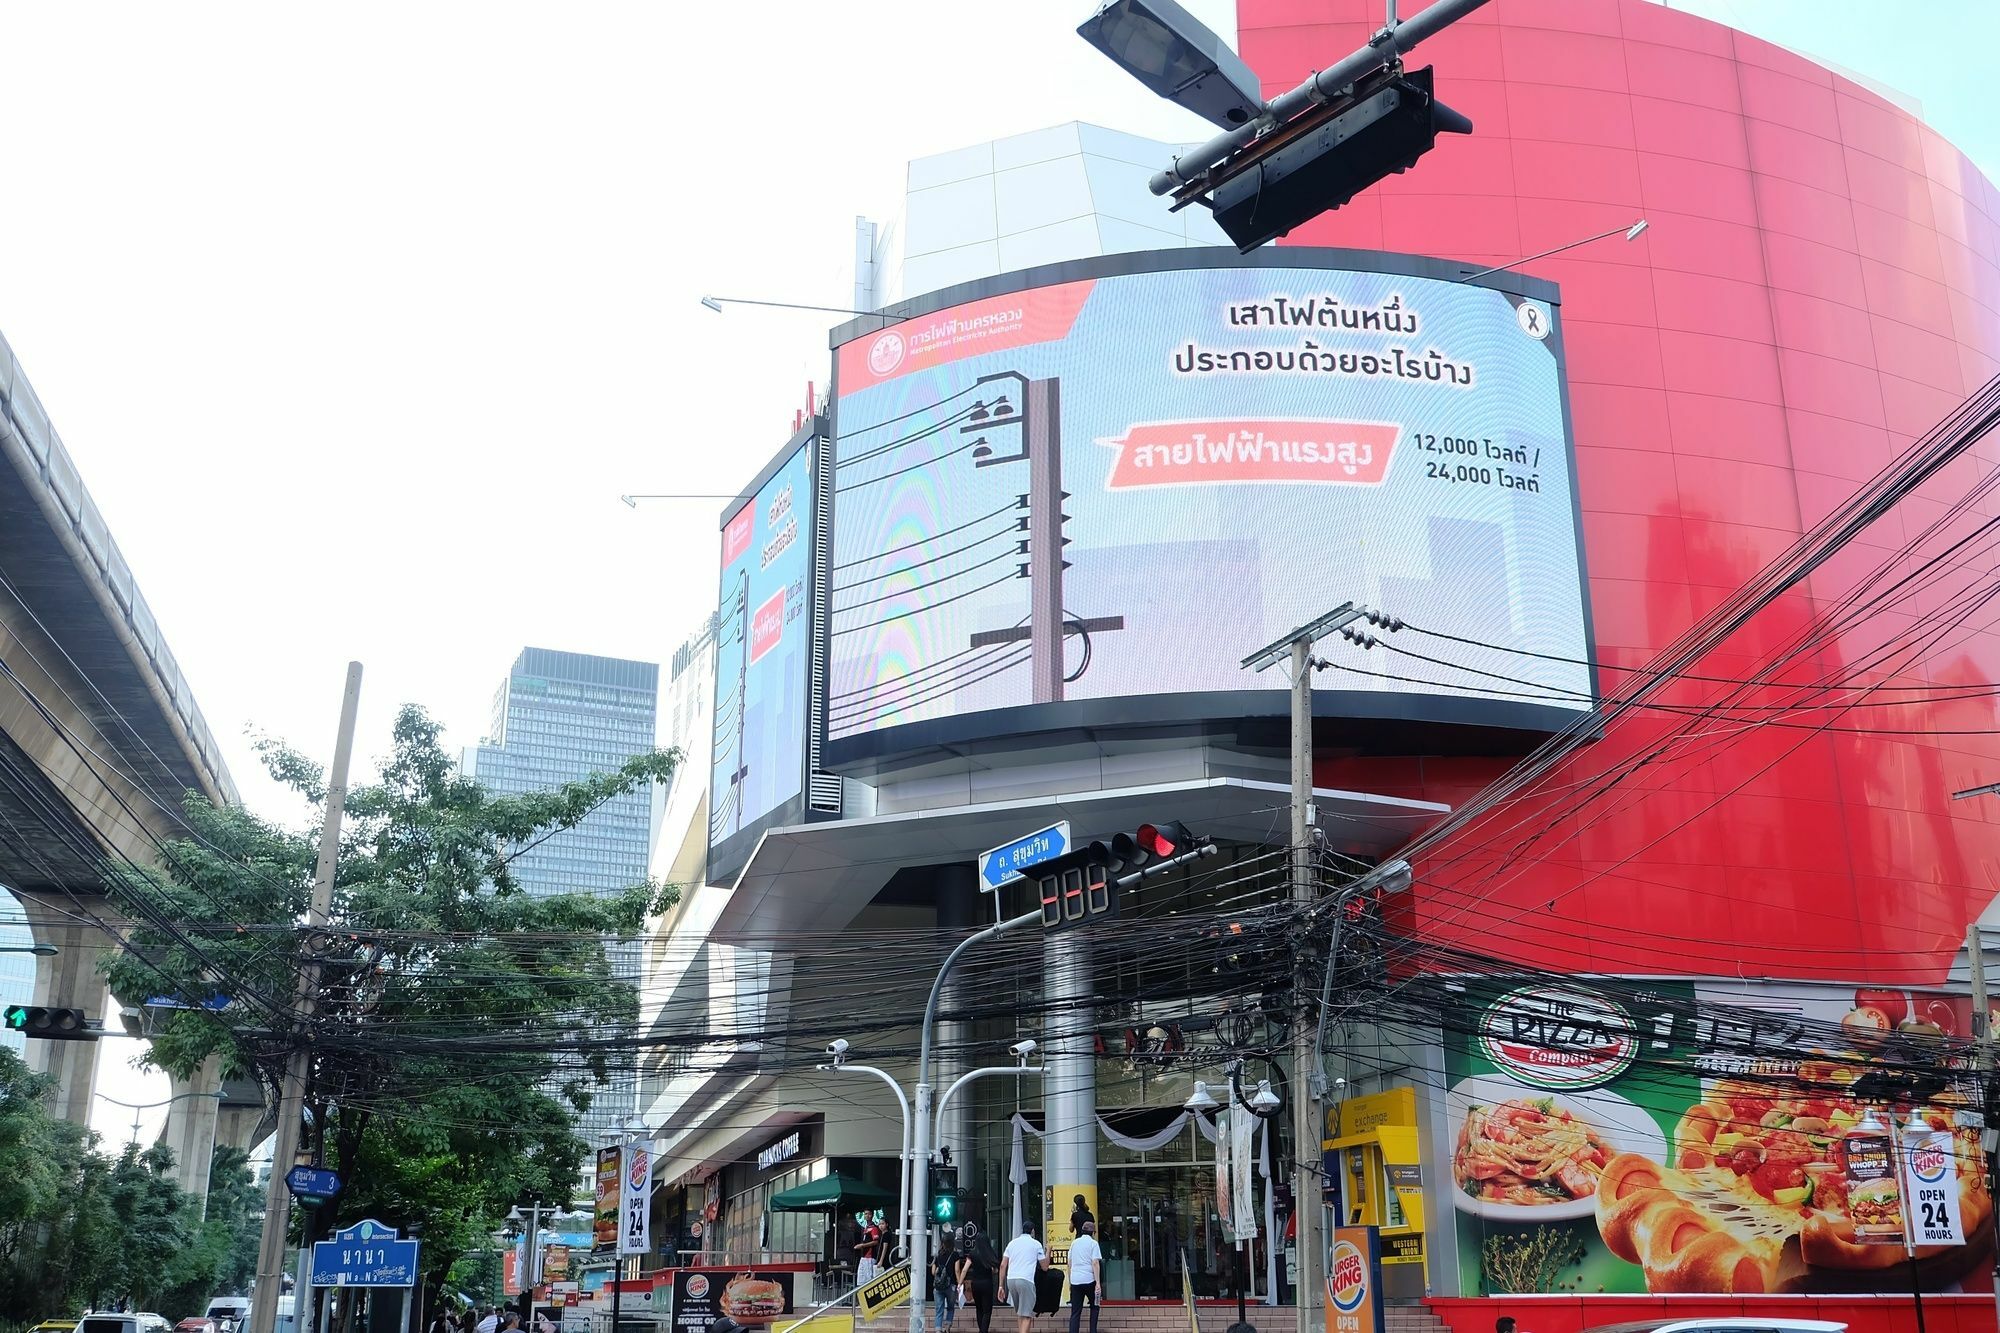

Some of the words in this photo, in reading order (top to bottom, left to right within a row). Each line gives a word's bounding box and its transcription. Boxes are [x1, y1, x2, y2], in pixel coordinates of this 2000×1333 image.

[1230, 296, 1417, 333] เสาไฟต้นหนึ่ง
[909, 308, 1023, 345] การไฟฟ้านครหลวง
[910, 338, 951, 355] Metropolitan
[952, 329, 987, 345] Electricity
[989, 323, 1023, 338] Authority
[1176, 341, 1471, 385] ประกอบด้วยอะไรบ้าง
[1132, 430, 1373, 476] สายไฟฟ้าแรงสูง
[1413, 433, 1477, 457] 12,000
[1484, 439, 1529, 465] โวลต์
[1426, 462, 1491, 486] 24,000
[1498, 467, 1540, 494] โวลต์
[1013, 837, 1049, 865] สุขุมวิท
[1510, 1014, 1614, 1045] PIZZA
[1529, 1049, 1596, 1066] Company
[1354, 1112, 1388, 1127] exchange
[782, 1132, 799, 1160] COFFEE
[1912, 1145, 1943, 1164] BURGER
[631, 1161, 648, 1181] KING
[1914, 1154, 1945, 1174] KING
[294, 1170, 316, 1182] สุขุมวิท
[328, 1176, 335, 1190] 3
[629, 1197, 644, 1210] OPEN
[1920, 1189, 1946, 1201] OPEN
[629, 1210, 644, 1237] 24
[1921, 1202, 1950, 1228] 24
[1392, 1239, 1419, 1249] WESTERN
[1925, 1229, 1953, 1240] HOURS
[1400, 1247, 1419, 1256] UNION
[1334, 1255, 1360, 1276] URGER
[690, 1283, 707, 1292] KING
[865, 1269, 906, 1299] WESTERN
[879, 1277, 907, 1299] UNION
[1332, 1266, 1362, 1296] KING
[677, 1317, 704, 1325] HOME
[704, 1317, 716, 1325] OF
[1336, 1316, 1359, 1330] OPEN
